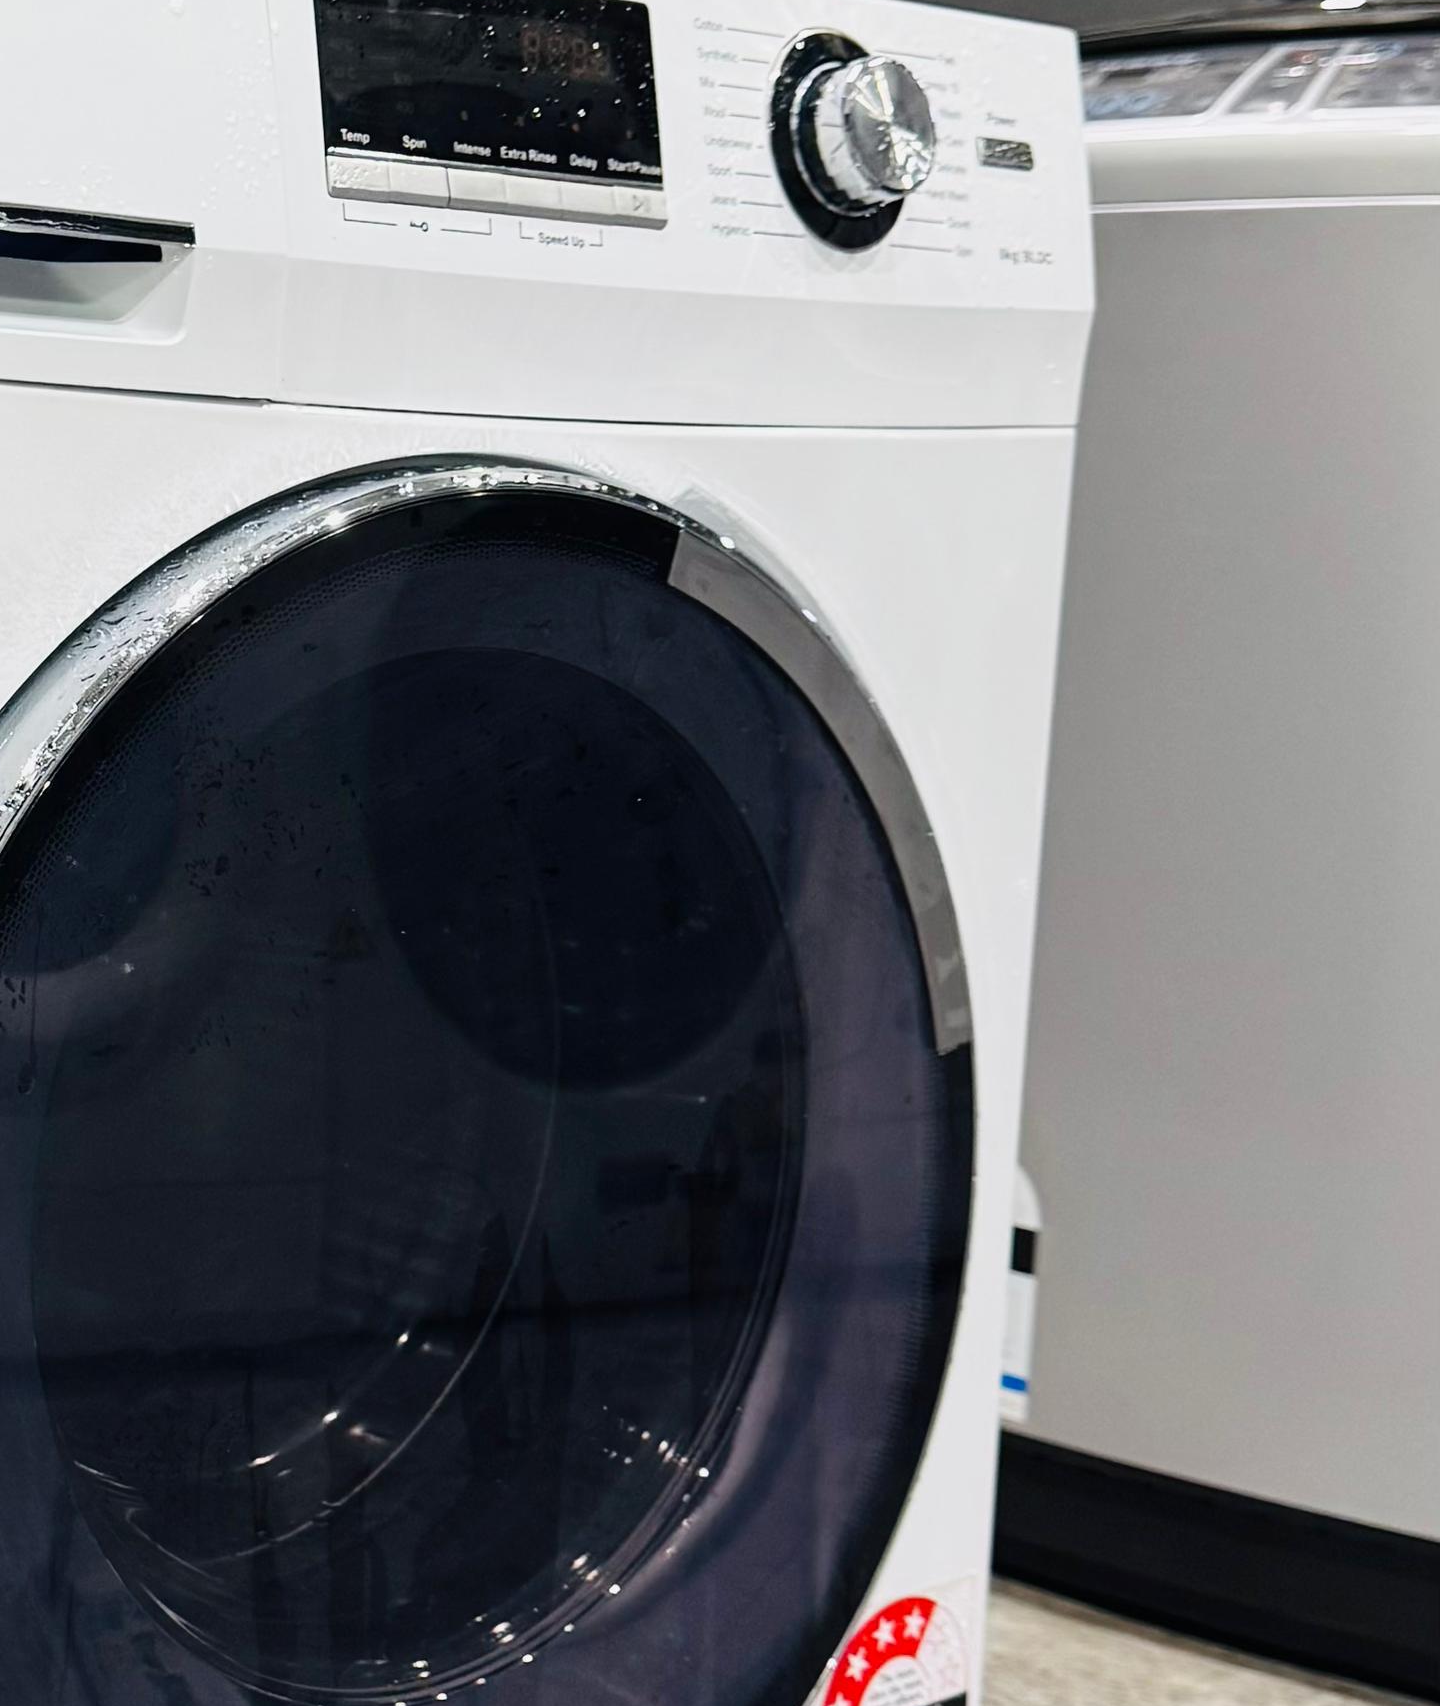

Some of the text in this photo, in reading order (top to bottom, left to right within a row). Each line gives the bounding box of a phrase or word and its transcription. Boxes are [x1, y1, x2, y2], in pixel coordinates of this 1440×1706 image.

[340, 128, 370, 145] Temp
[402, 135, 427, 150] Spin
[453, 141, 491, 157] Intense
[500, 145, 558, 164] Extra Rinse
[569, 153, 598, 171] Delay
[538, 231, 585, 250] Speed Up
